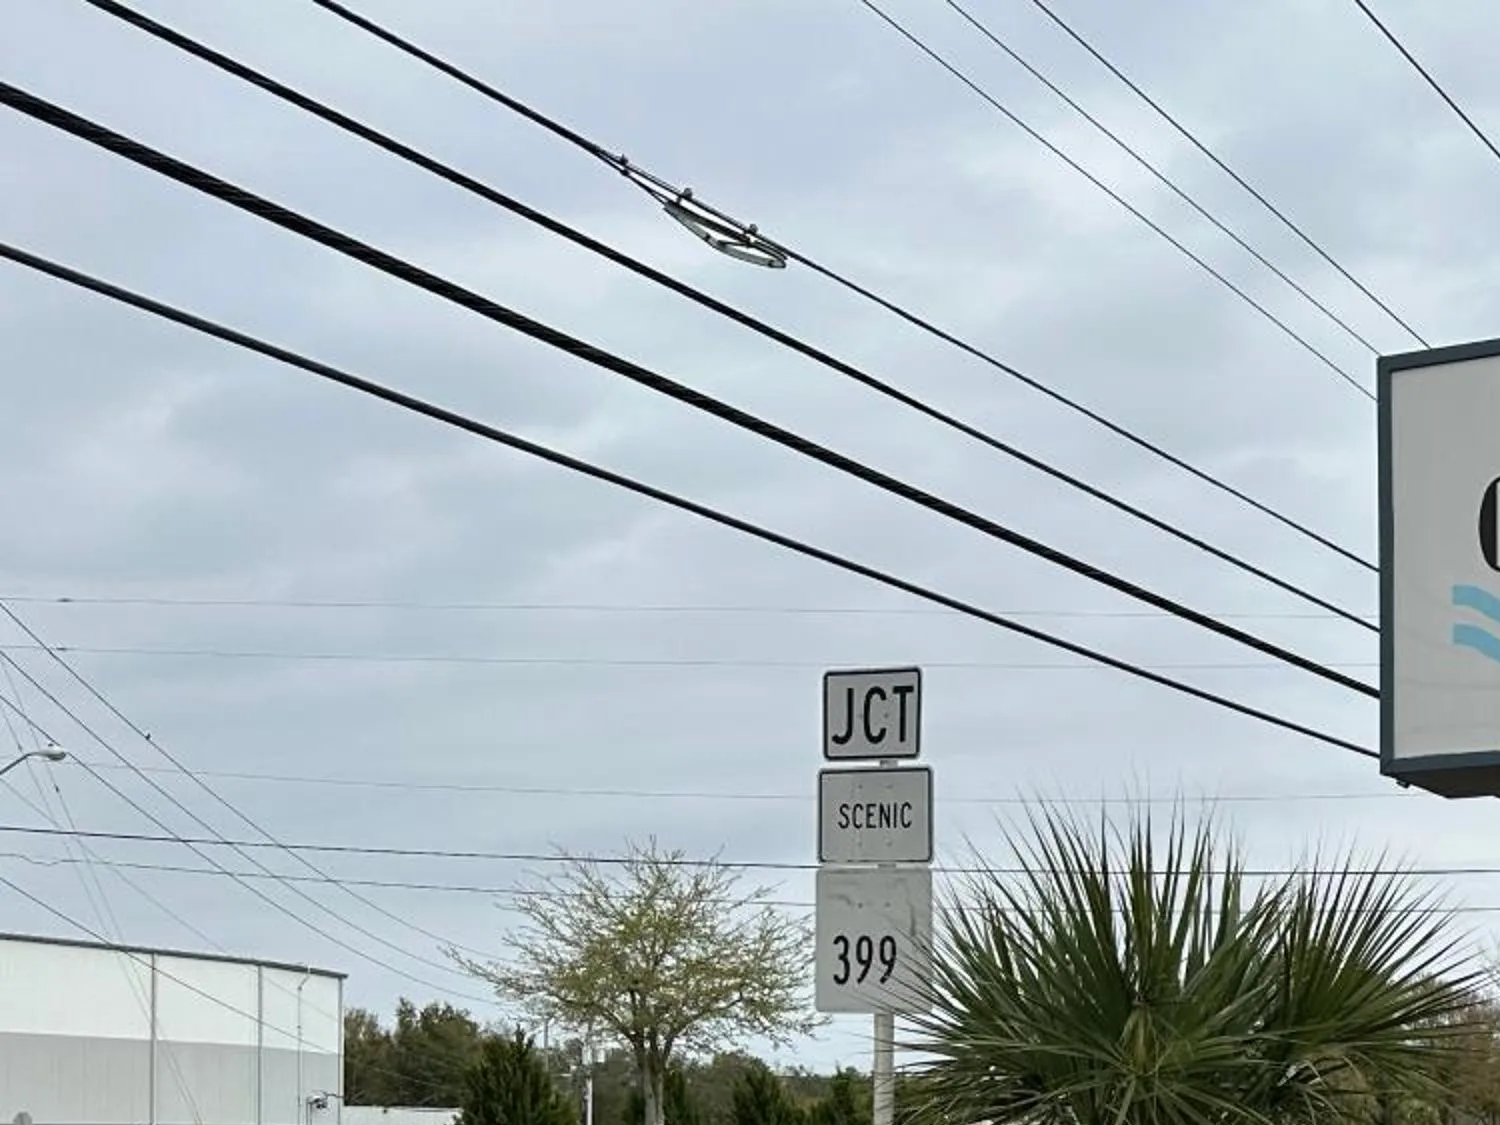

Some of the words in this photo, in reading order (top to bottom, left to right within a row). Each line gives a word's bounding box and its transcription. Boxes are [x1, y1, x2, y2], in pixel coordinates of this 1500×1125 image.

[831, 684, 914, 745] JCT
[837, 801, 912, 830] SCENIC
[832, 934, 897, 985] 399
